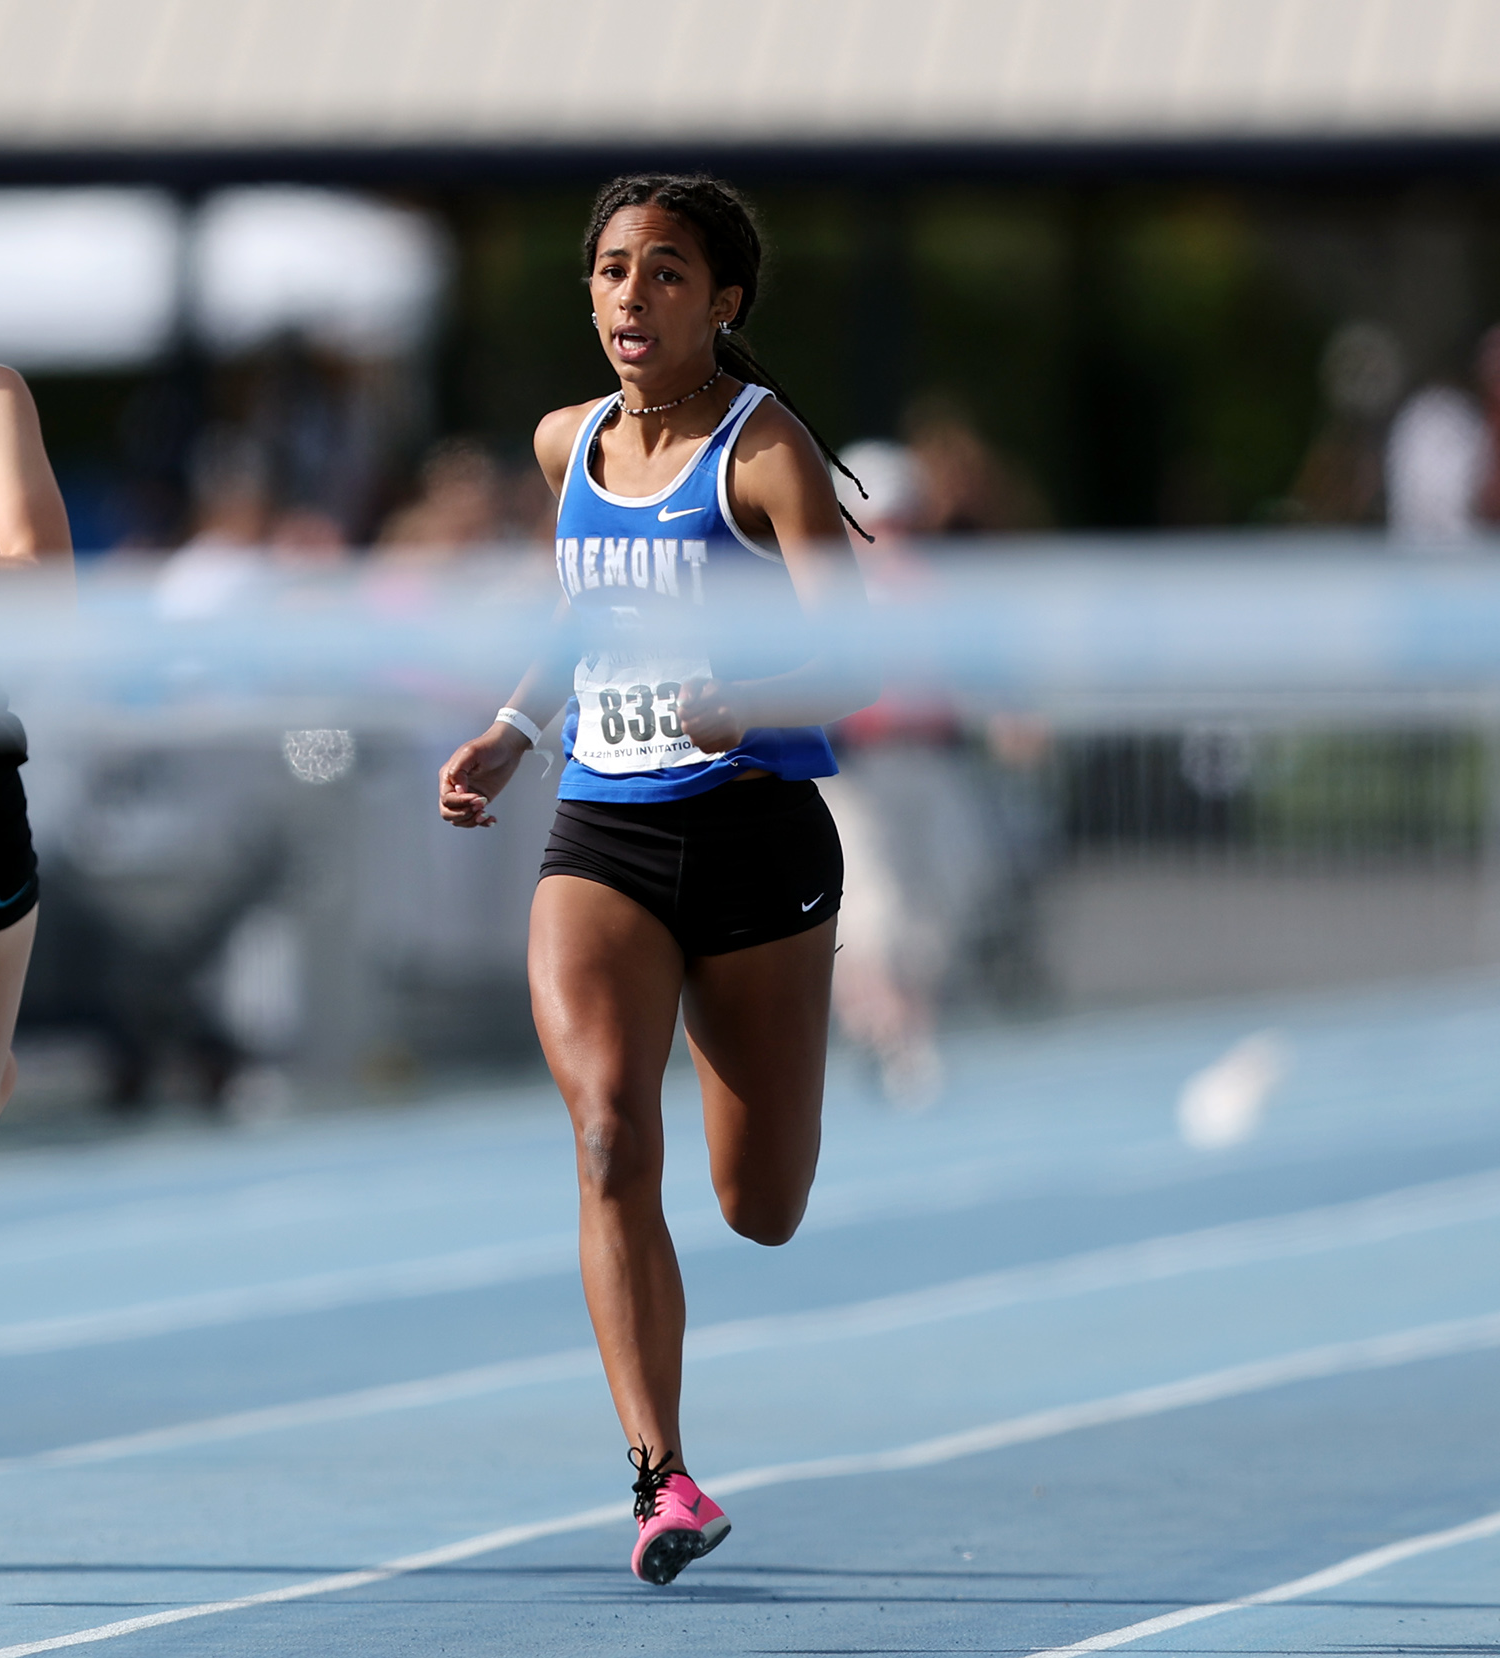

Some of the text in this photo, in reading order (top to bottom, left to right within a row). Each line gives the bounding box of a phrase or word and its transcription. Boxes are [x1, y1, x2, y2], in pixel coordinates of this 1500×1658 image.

[599, 682, 685, 745] 833
[614, 748, 632, 758] BYU
[636, 741, 695, 755] INVITATIO
